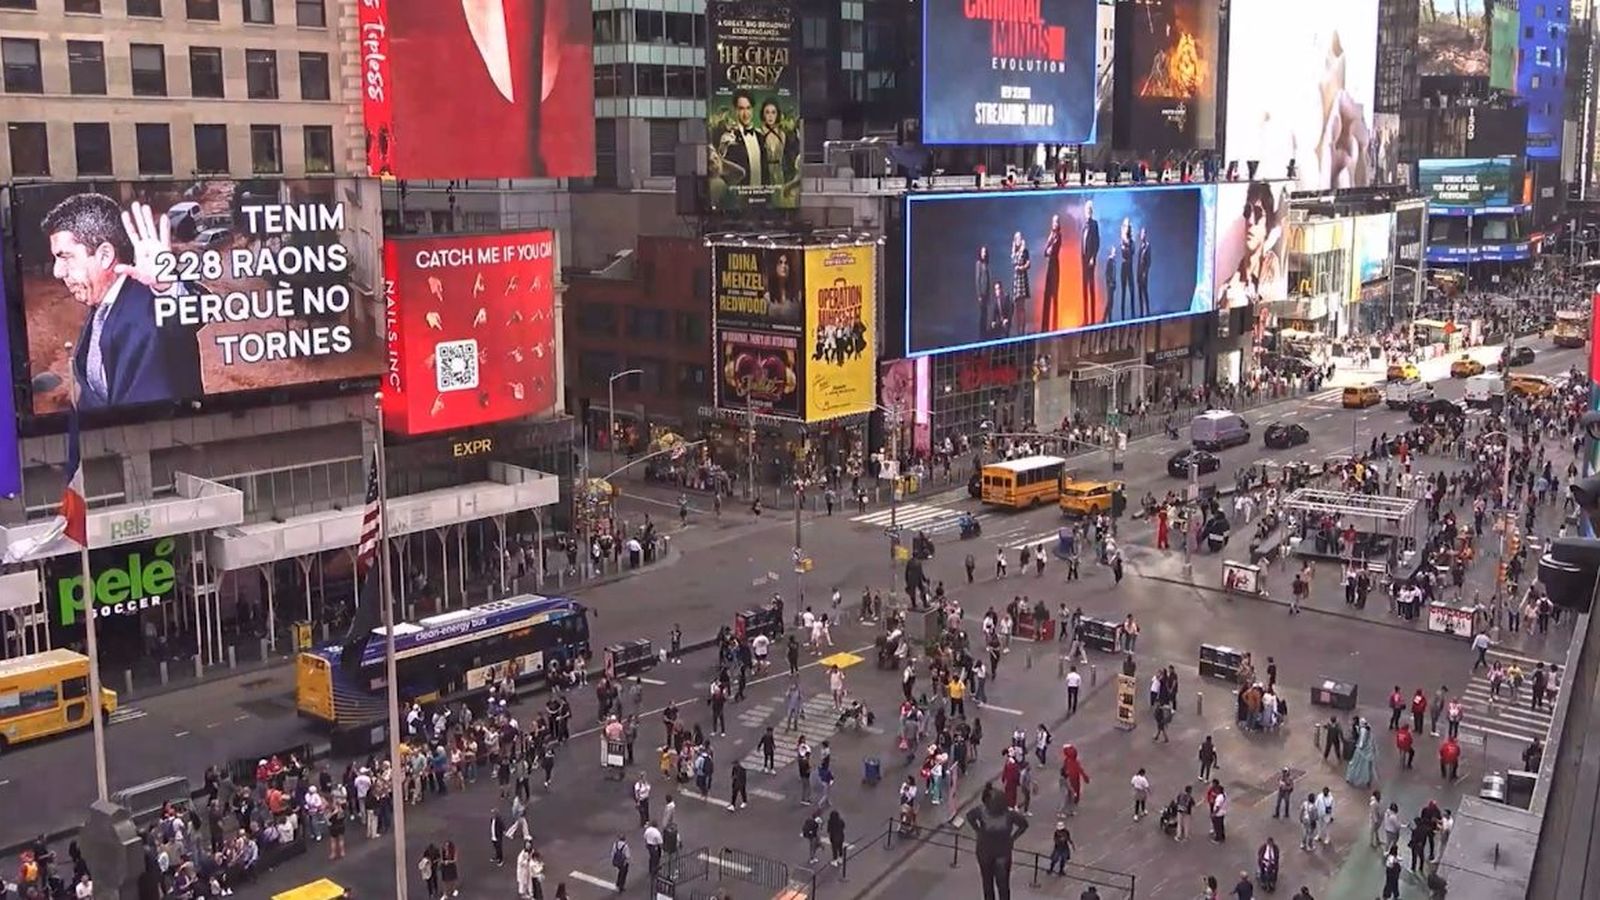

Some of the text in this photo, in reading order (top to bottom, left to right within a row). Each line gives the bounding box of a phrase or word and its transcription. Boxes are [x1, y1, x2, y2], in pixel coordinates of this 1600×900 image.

[719, 45, 789, 65] THE GREAT
[992, 57, 1065, 73] EVOLUTION
[726, 65, 784, 84] GATSBY
[975, 102, 1026, 125] STREAMING
[1028, 103, 1046, 126] MAY
[241, 203, 345, 233] TENIM
[155, 244, 348, 282] 228 RAONS
[416, 248, 474, 268] CATCH
[478, 246, 500, 264] ME
[503, 246, 515, 262] IF
[516, 243, 539, 261] YOU
[728, 253, 758, 271] IDINA
[722, 271, 765, 290] MENZEL
[154, 281, 350, 327] PERQUÈ NO
[720, 295, 767, 315] REDWOOD
[818, 285, 863, 309] OPERATION
[217, 325, 352, 364] TORNES
[454, 439, 492, 457] EXPR
[58, 537, 175, 626] pelé
[415, 616, 487, 642] clean-energy bus
